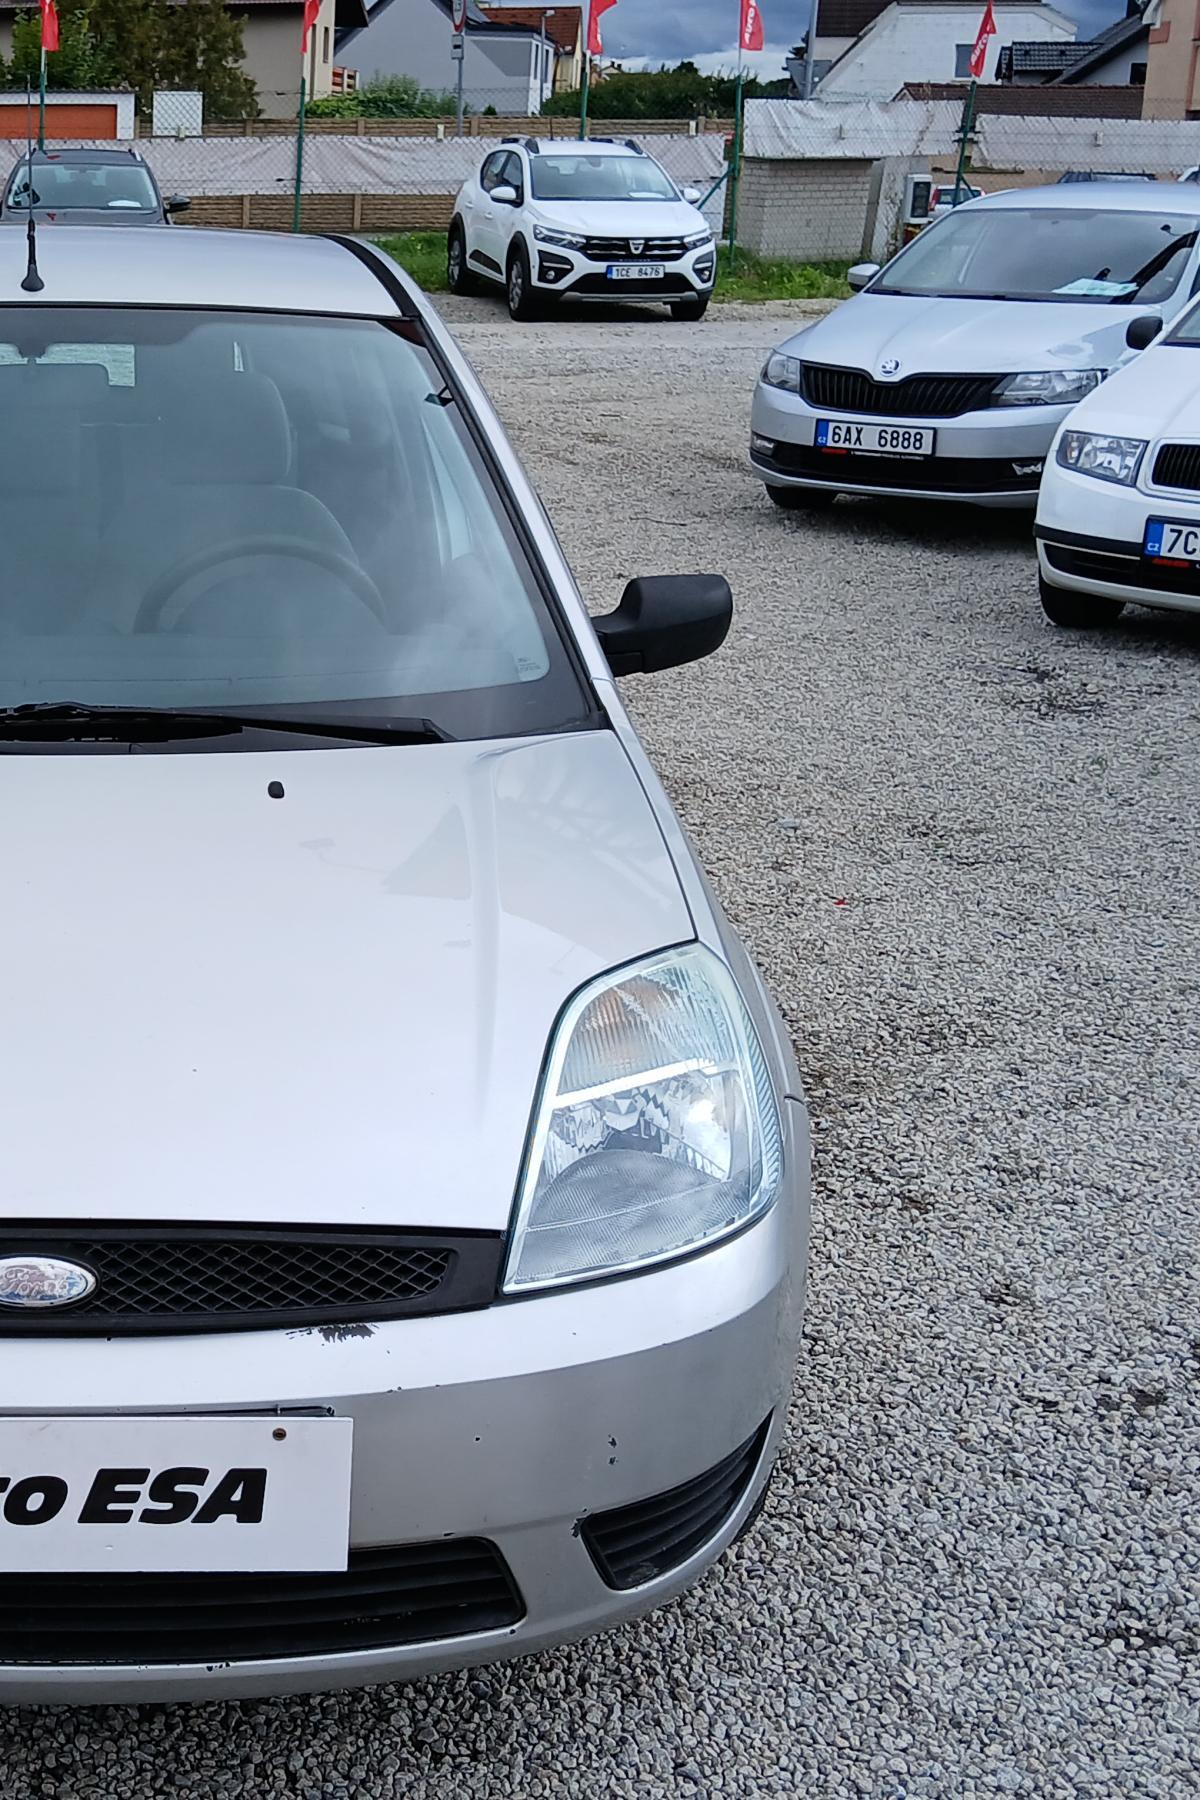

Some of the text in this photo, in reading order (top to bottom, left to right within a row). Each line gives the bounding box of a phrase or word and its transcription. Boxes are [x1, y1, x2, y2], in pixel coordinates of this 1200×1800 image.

[615, 267, 660, 277] 1CE 8476
[831, 425, 924, 450] 6AX 6888
[1147, 542, 1160, 552] CZ
[1167, 528, 1200, 555] 7C
[77, 1466, 267, 1525] ESA
